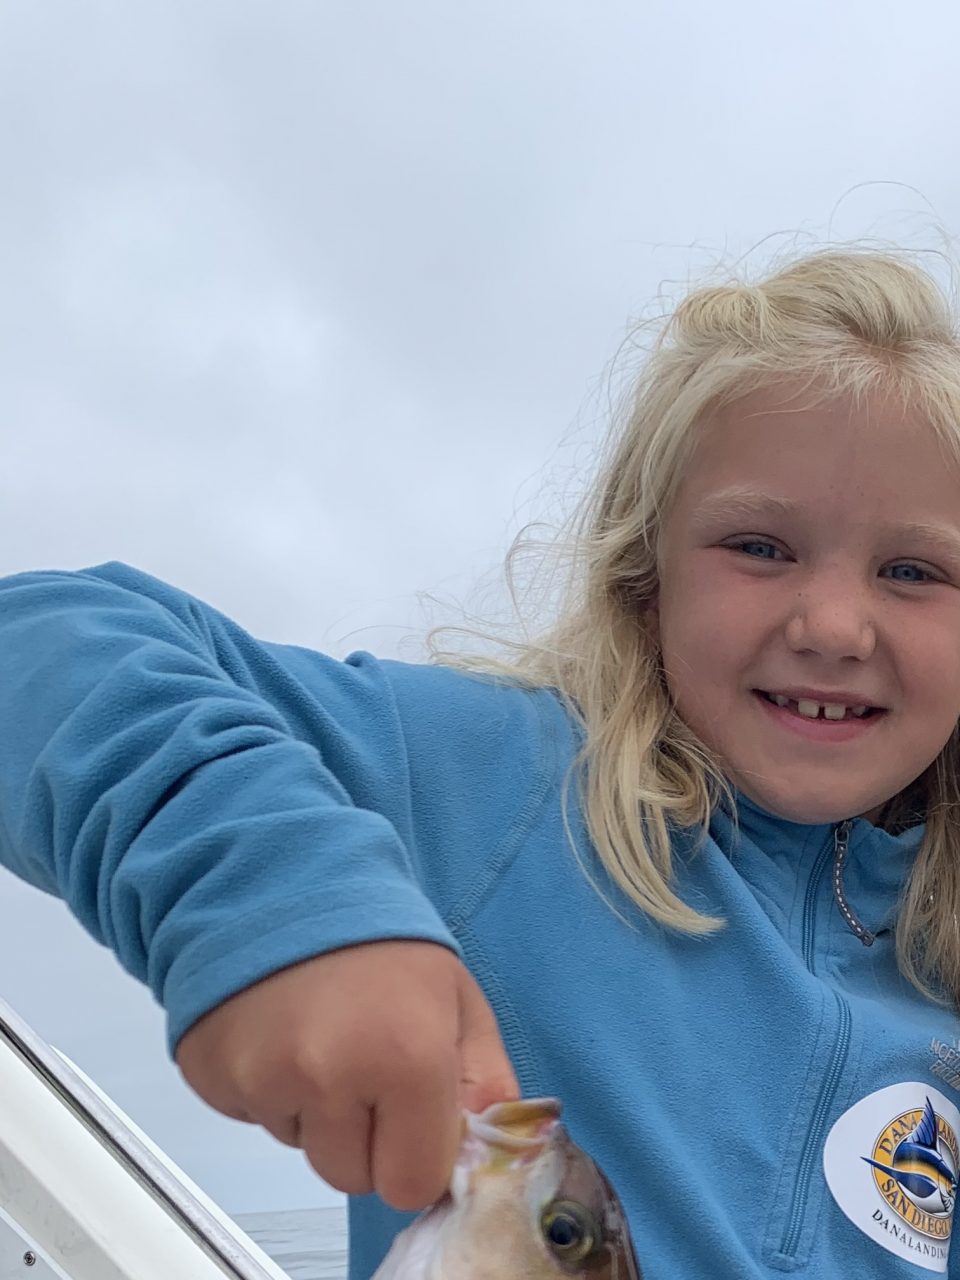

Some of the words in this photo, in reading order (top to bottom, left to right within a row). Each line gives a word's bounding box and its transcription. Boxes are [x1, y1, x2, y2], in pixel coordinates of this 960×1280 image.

[878, 1113, 918, 1156] DANA
[881, 1178, 911, 1216] SAN
[911, 1209, 948, 1236] DIEGO
